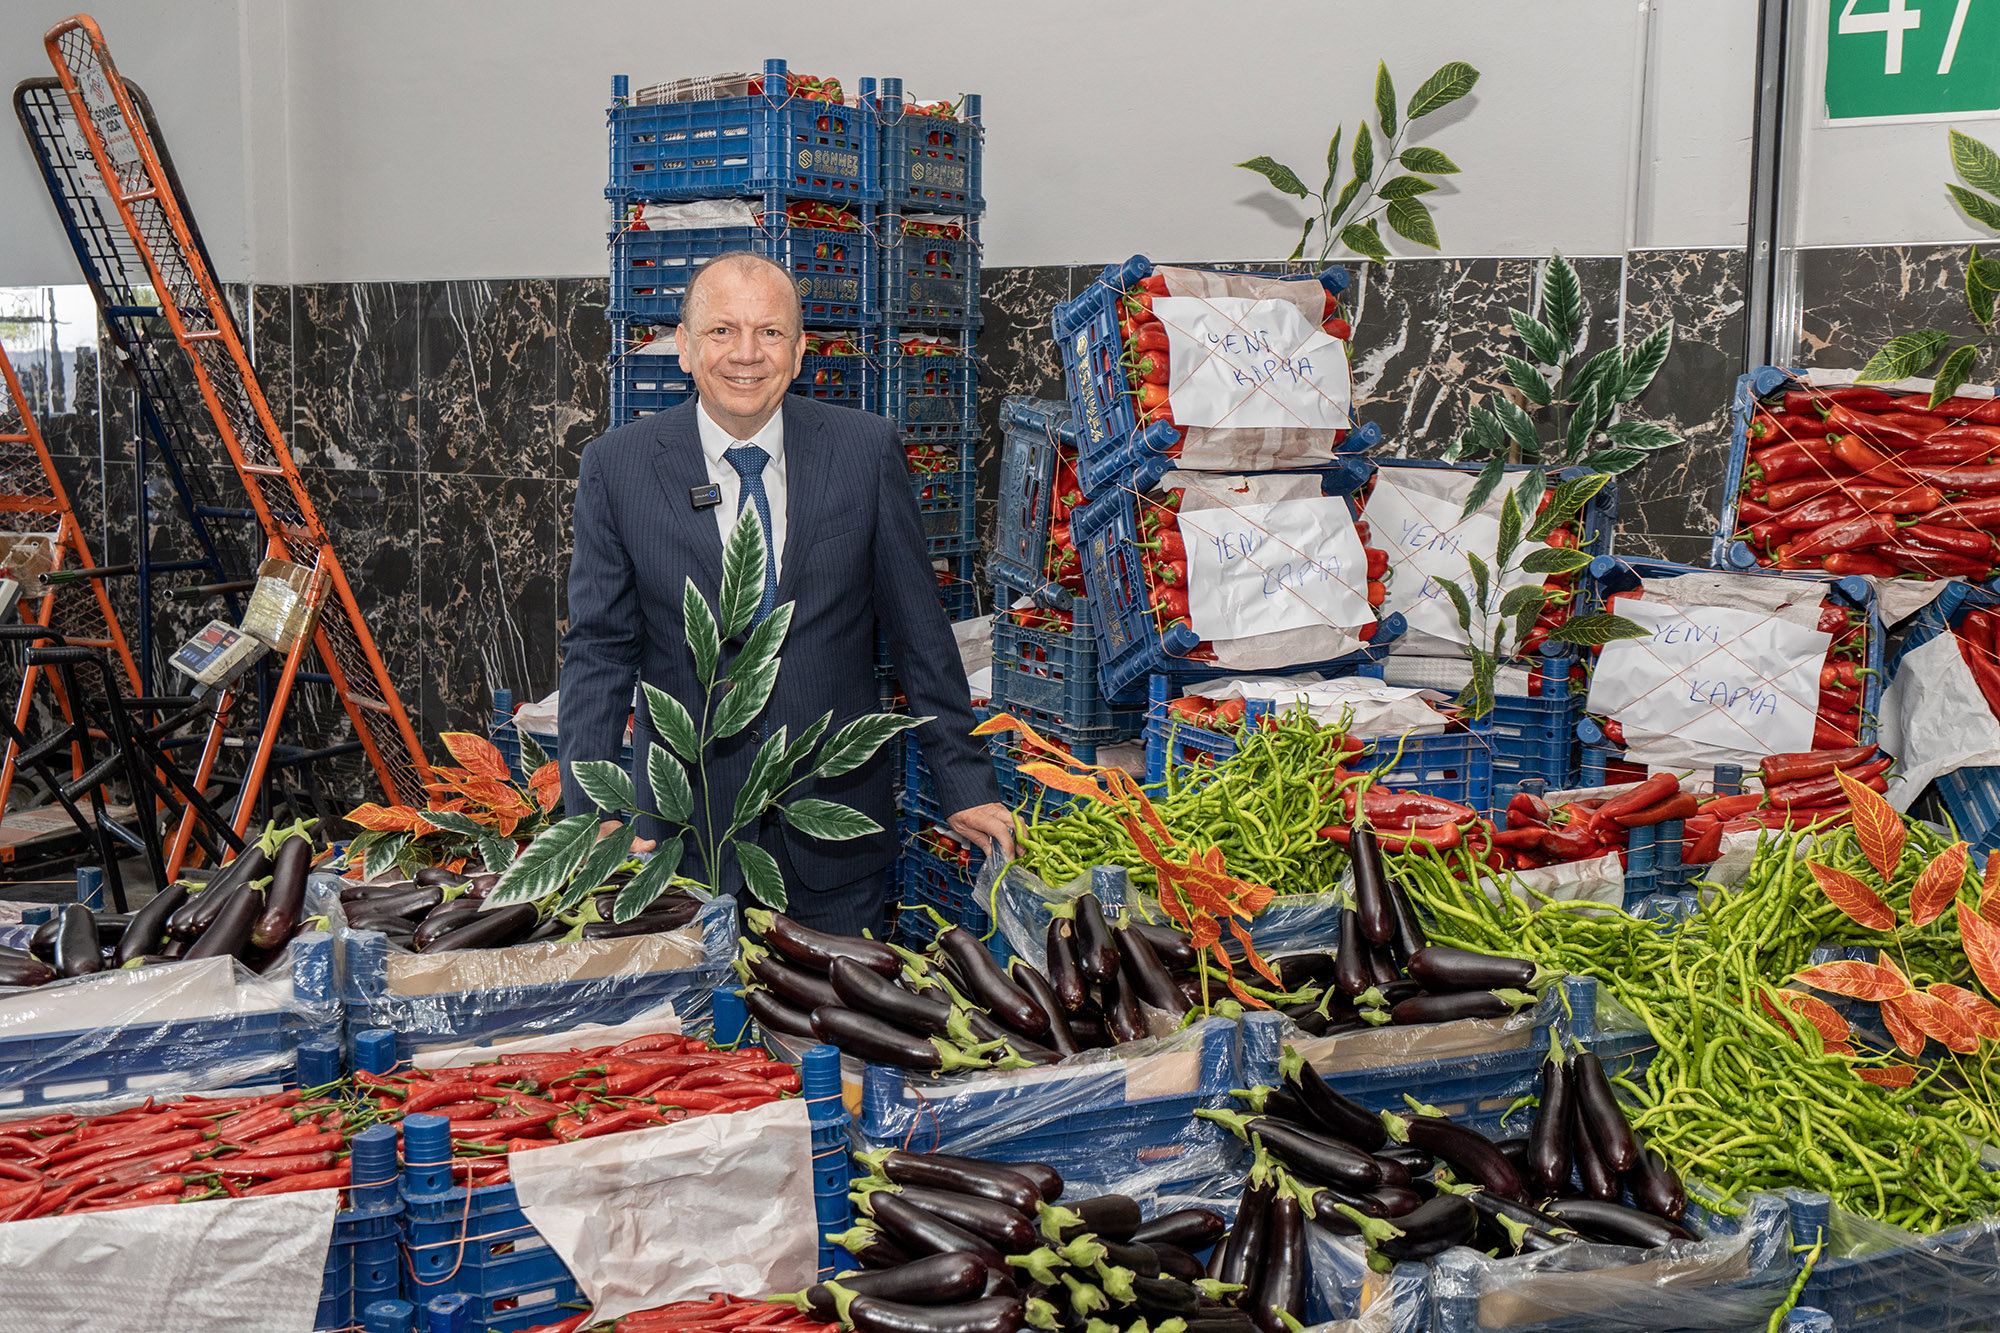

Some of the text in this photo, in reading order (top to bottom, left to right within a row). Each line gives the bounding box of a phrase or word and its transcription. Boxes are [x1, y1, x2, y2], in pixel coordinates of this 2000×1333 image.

[814, 150, 858, 170] SÖNMEZ
[1233, 357, 1315, 388] KAPYA
[1262, 555, 1342, 599] KAPYA
[1689, 680, 1777, 715] KAPYA
